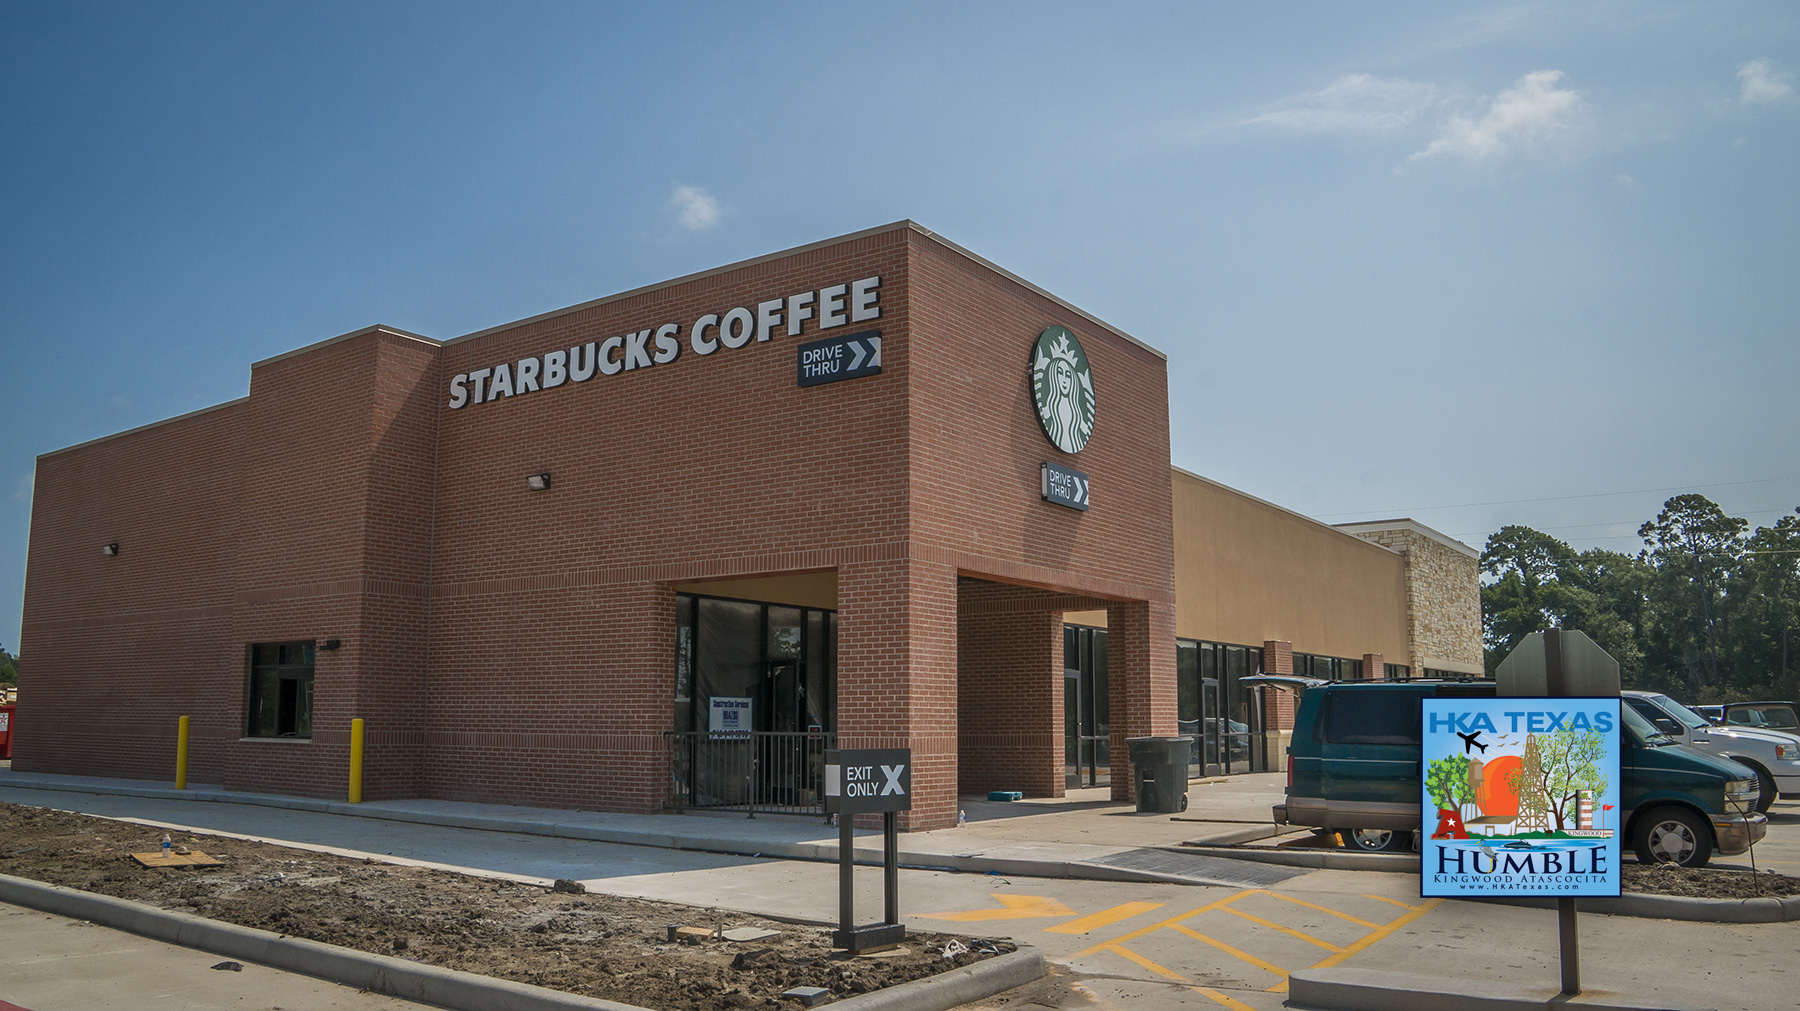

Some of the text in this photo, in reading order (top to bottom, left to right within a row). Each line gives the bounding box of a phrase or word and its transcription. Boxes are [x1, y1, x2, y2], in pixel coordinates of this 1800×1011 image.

[448, 275, 881, 410] STARBUCKS COFFEE
[803, 343, 843, 365] DRIVE
[803, 359, 840, 378] THRU
[1050, 470, 1071, 487] DRIVE
[1050, 483, 1070, 499] THRU
[846, 766, 873, 781] EXIT
[846, 781, 879, 798] ONLY
